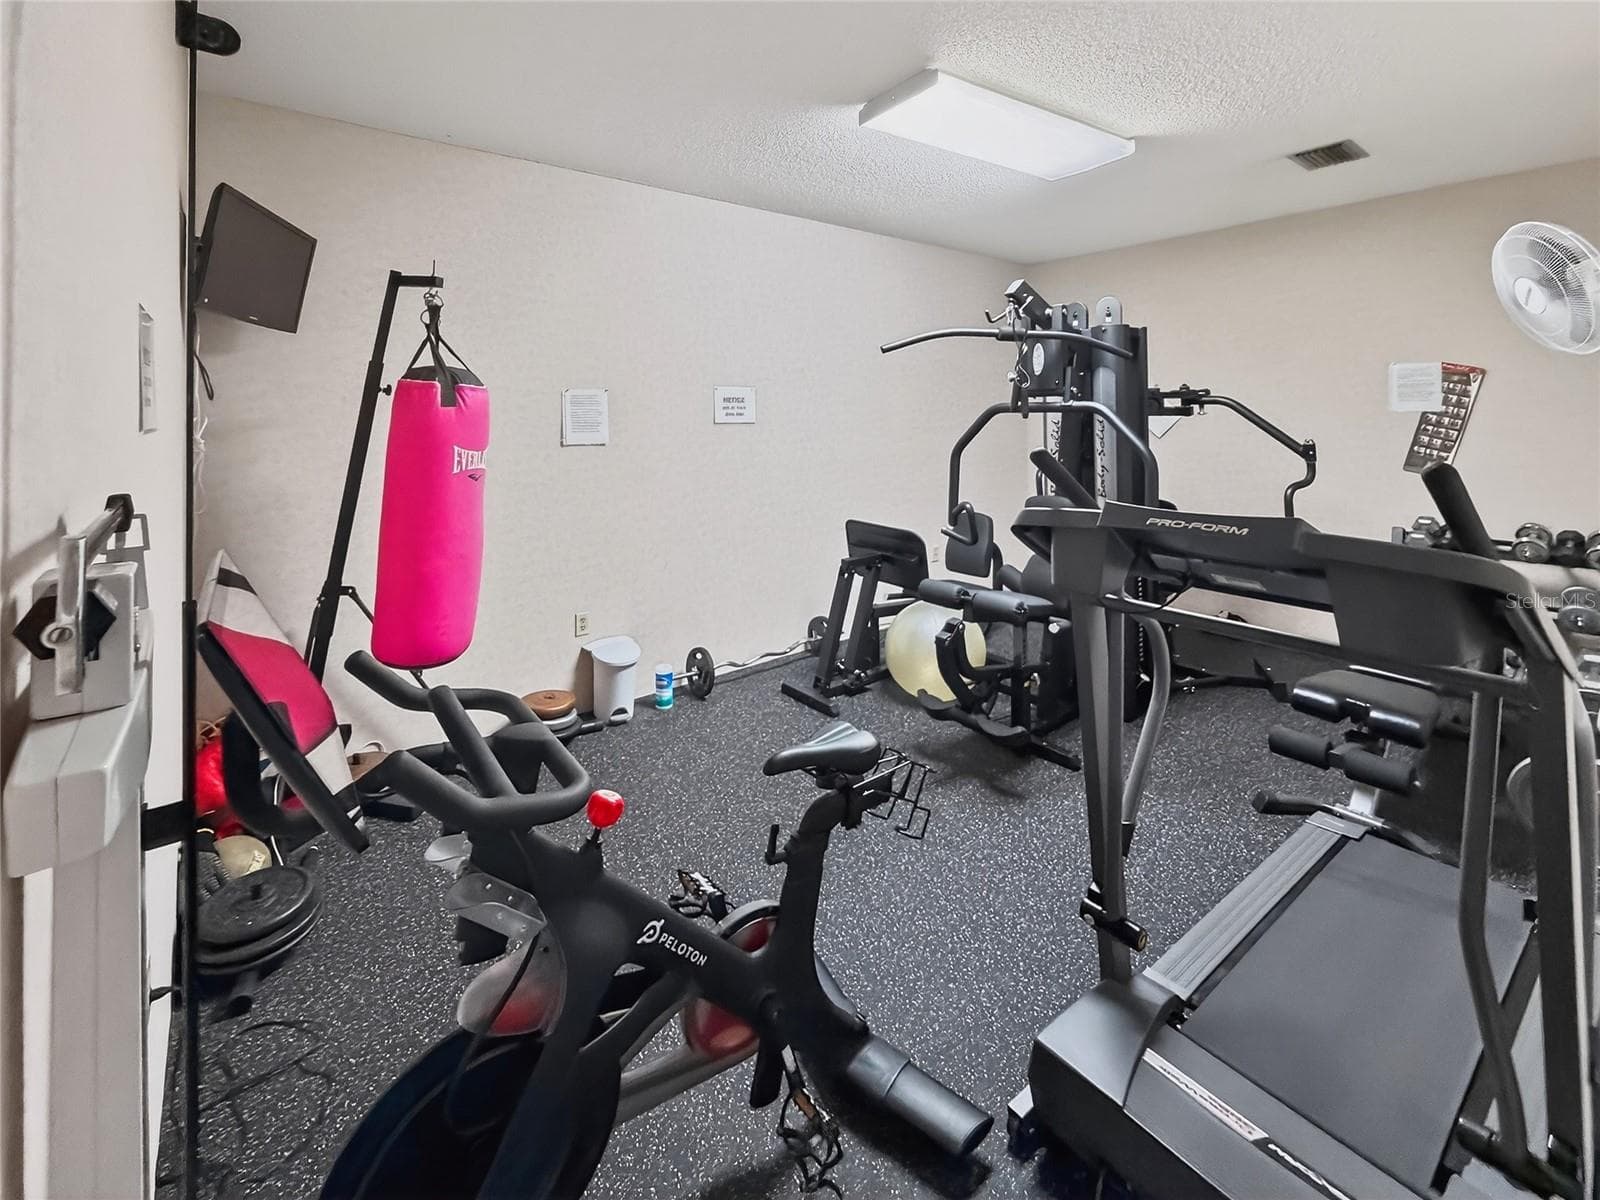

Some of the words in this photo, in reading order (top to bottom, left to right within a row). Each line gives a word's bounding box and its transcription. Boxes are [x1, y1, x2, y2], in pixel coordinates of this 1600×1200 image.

[1096, 418, 1109, 498] Body-Solid
[1146, 518, 1249, 535] PRO-FORM
[659, 933, 708, 966] PELOTON
